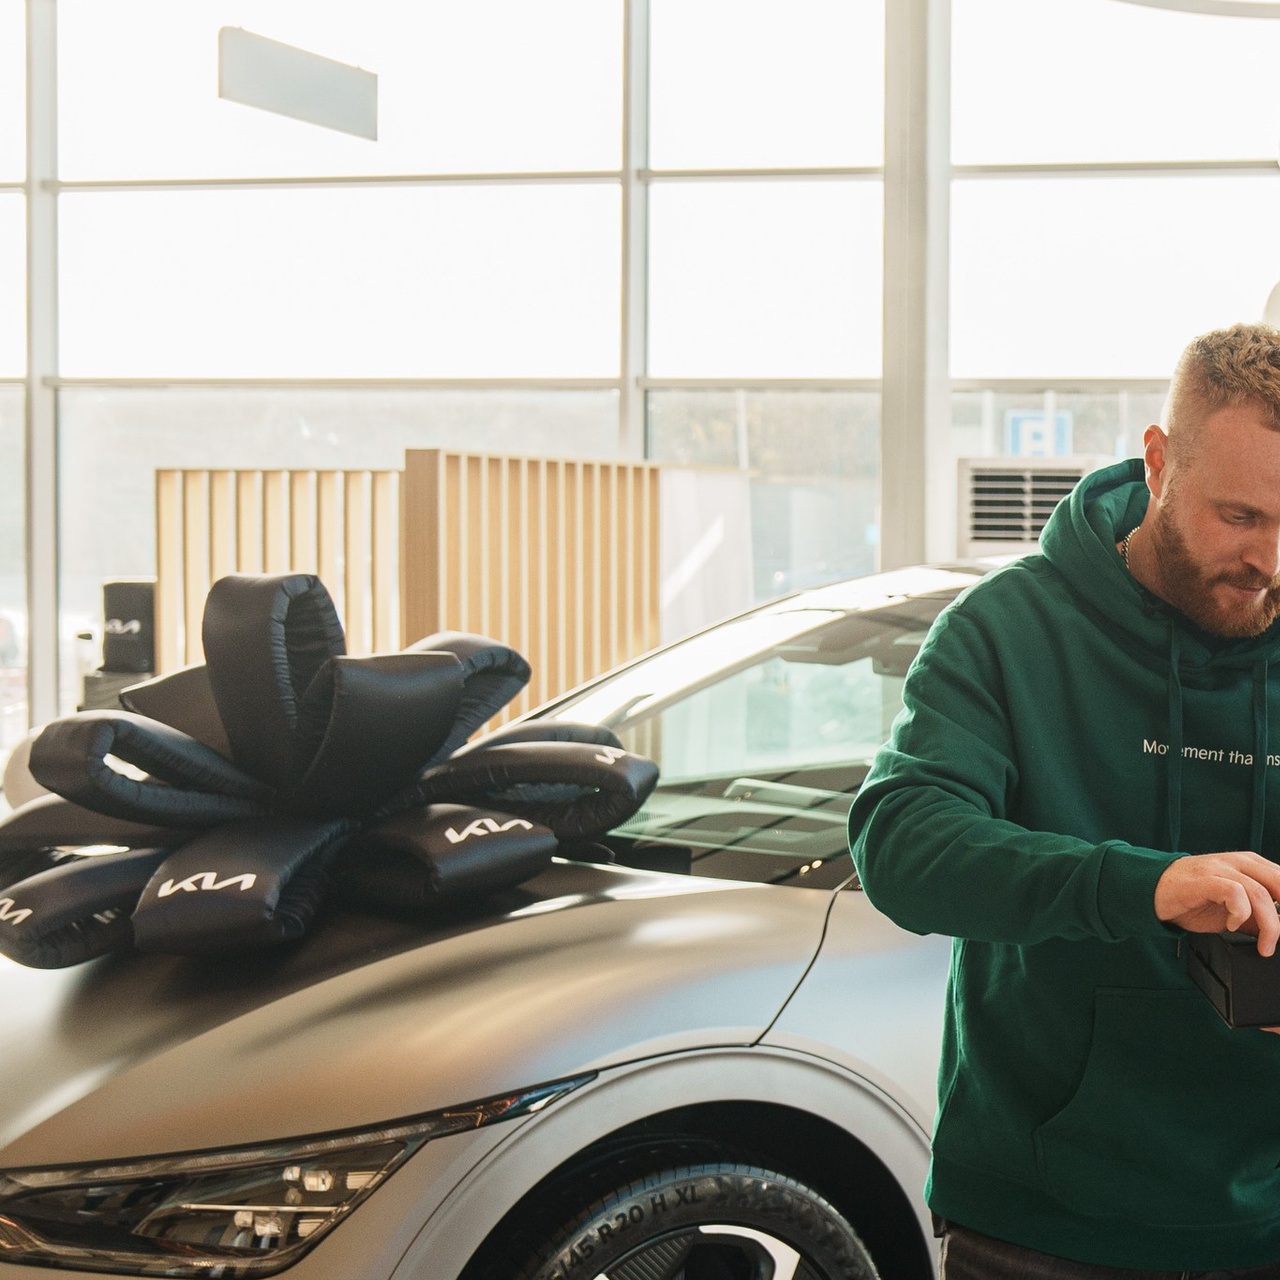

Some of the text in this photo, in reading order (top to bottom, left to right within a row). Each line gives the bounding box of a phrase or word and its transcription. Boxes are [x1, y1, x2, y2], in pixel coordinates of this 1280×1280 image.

[1143, 739, 1224, 762] Moment
[1229, 750, 1253, 765] tha
[650, 1194, 668, 1216] H
[674, 1185, 702, 1208] XL
